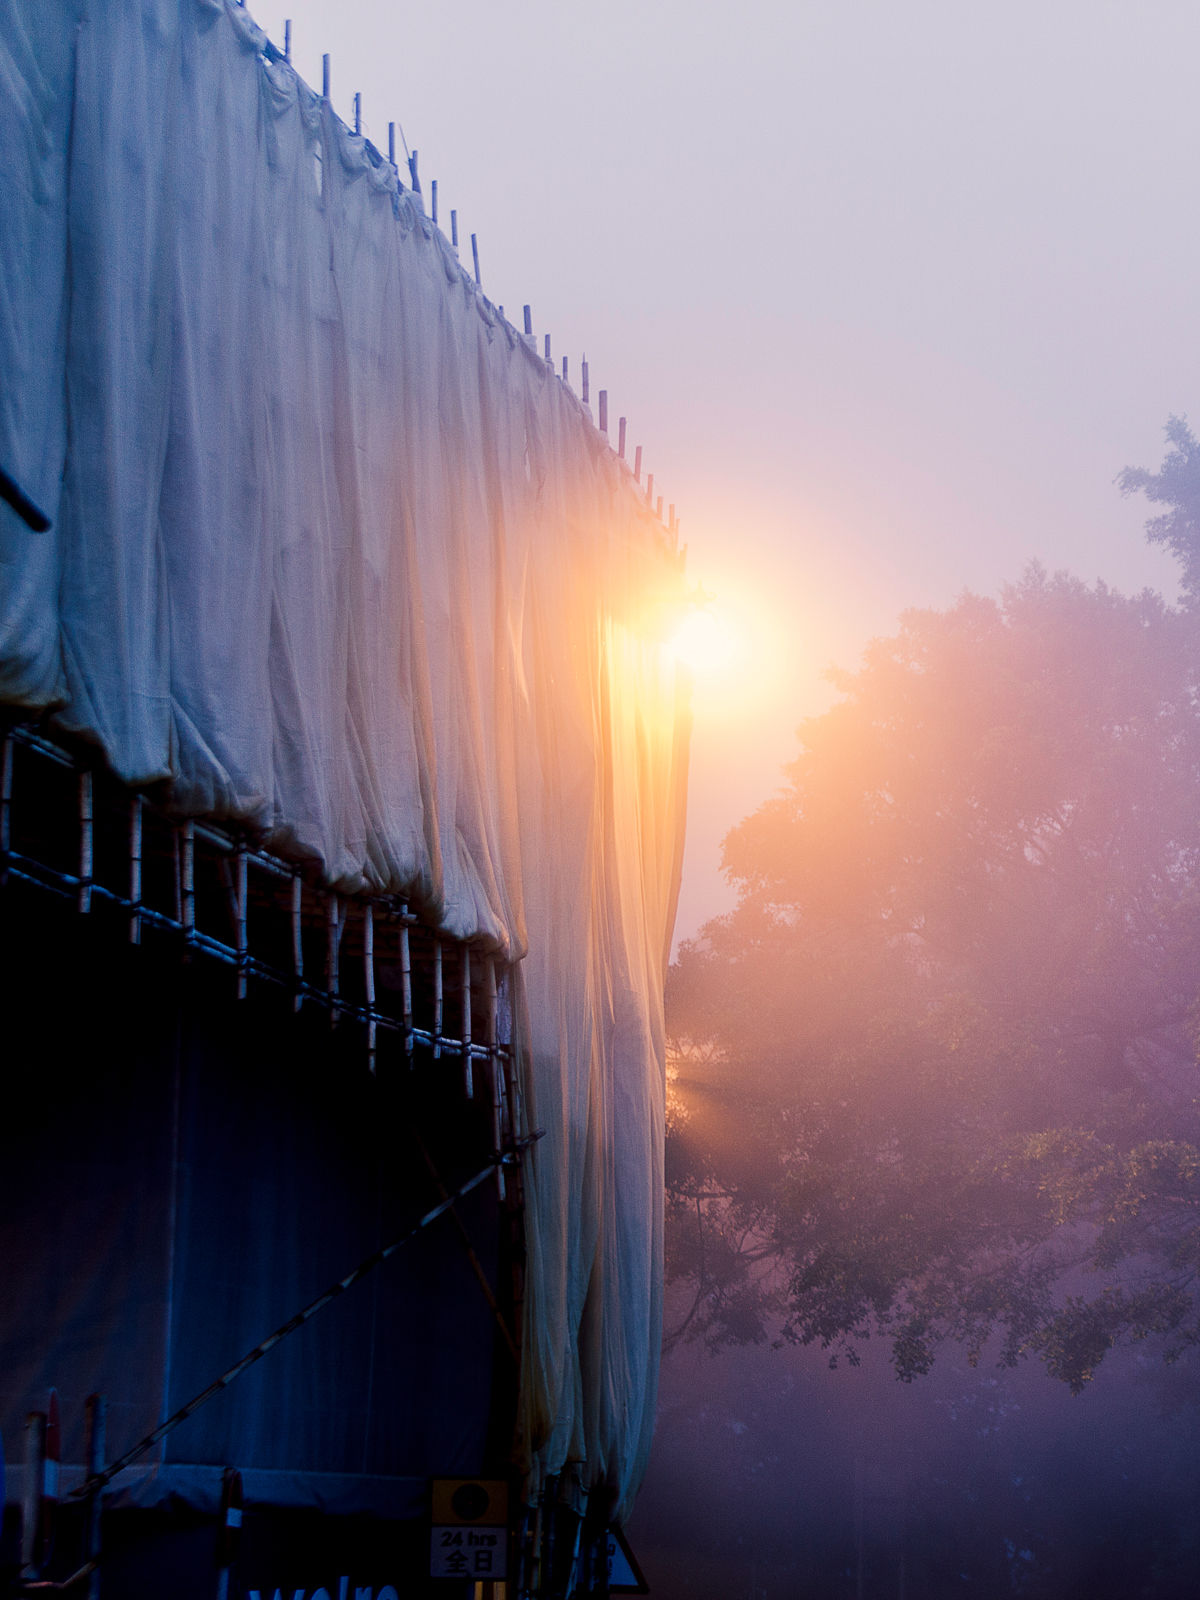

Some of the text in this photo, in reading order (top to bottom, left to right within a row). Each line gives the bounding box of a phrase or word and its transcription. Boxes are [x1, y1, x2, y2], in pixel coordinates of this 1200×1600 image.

[440, 1531, 497, 1547] 24 hrs
[445, 1548, 493, 1573] 全日
